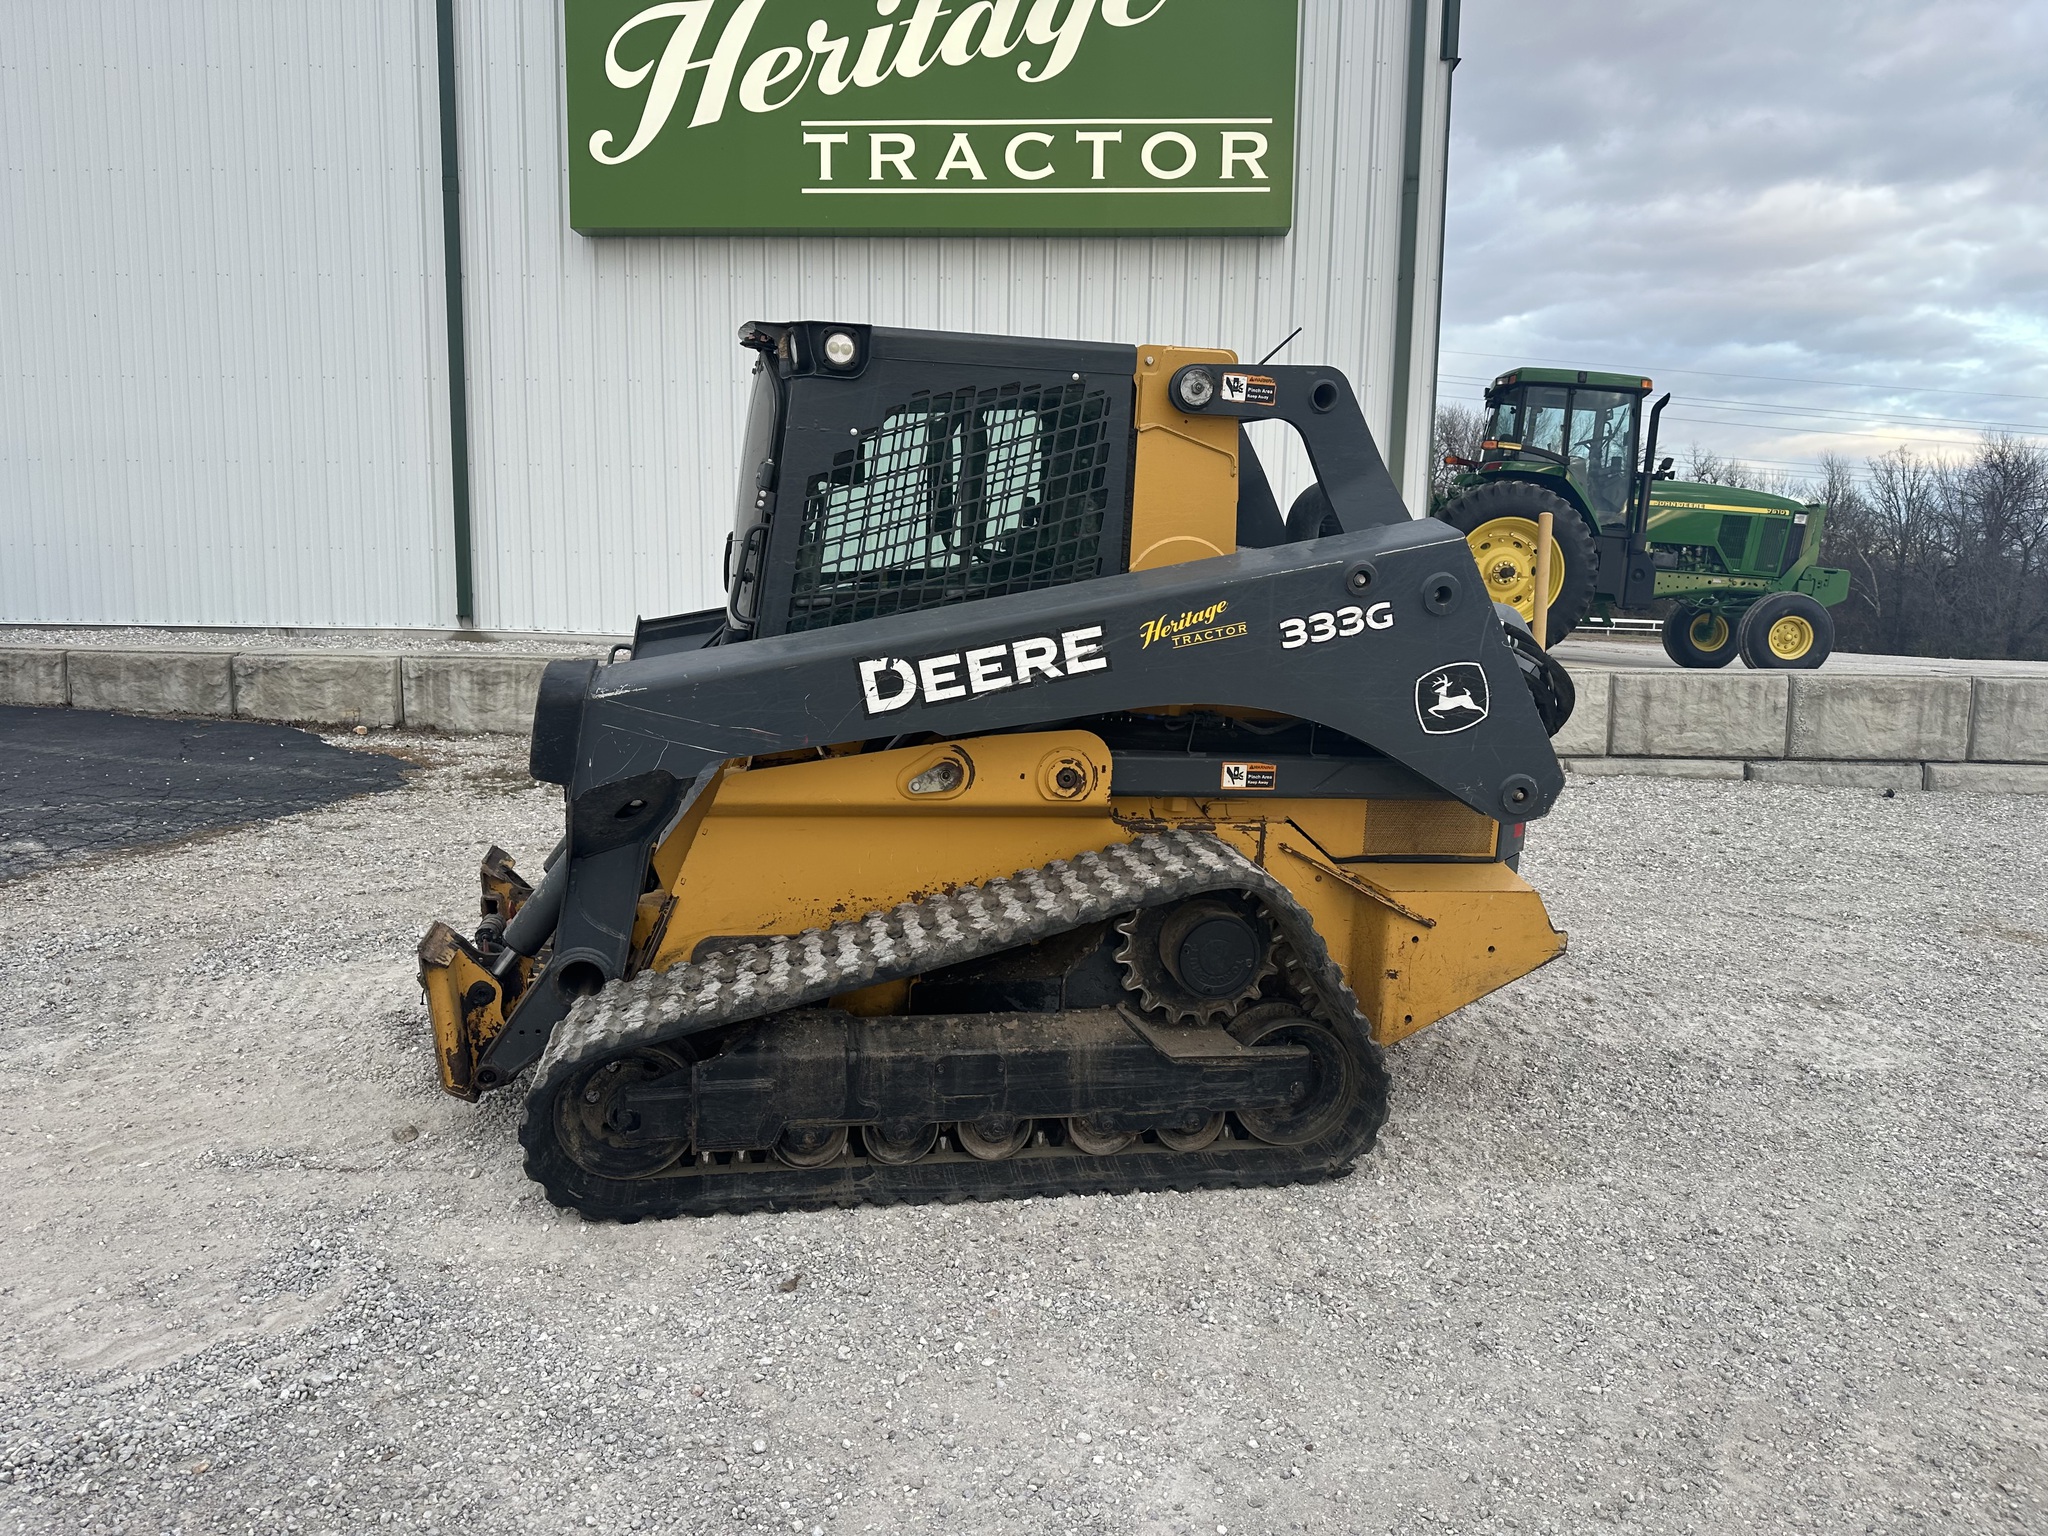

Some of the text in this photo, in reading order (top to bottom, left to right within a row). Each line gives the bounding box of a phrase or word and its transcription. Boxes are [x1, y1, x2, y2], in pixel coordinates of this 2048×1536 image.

[802, 130, 1270, 181] TRACTOR
[1654, 500, 1675, 508] JOHN
[1140, 600, 1228, 650] Heritage
[1172, 624, 1247, 647] TRACTOR
[1279, 601, 1394, 649] 333G
[859, 625, 1108, 715] DEERE
